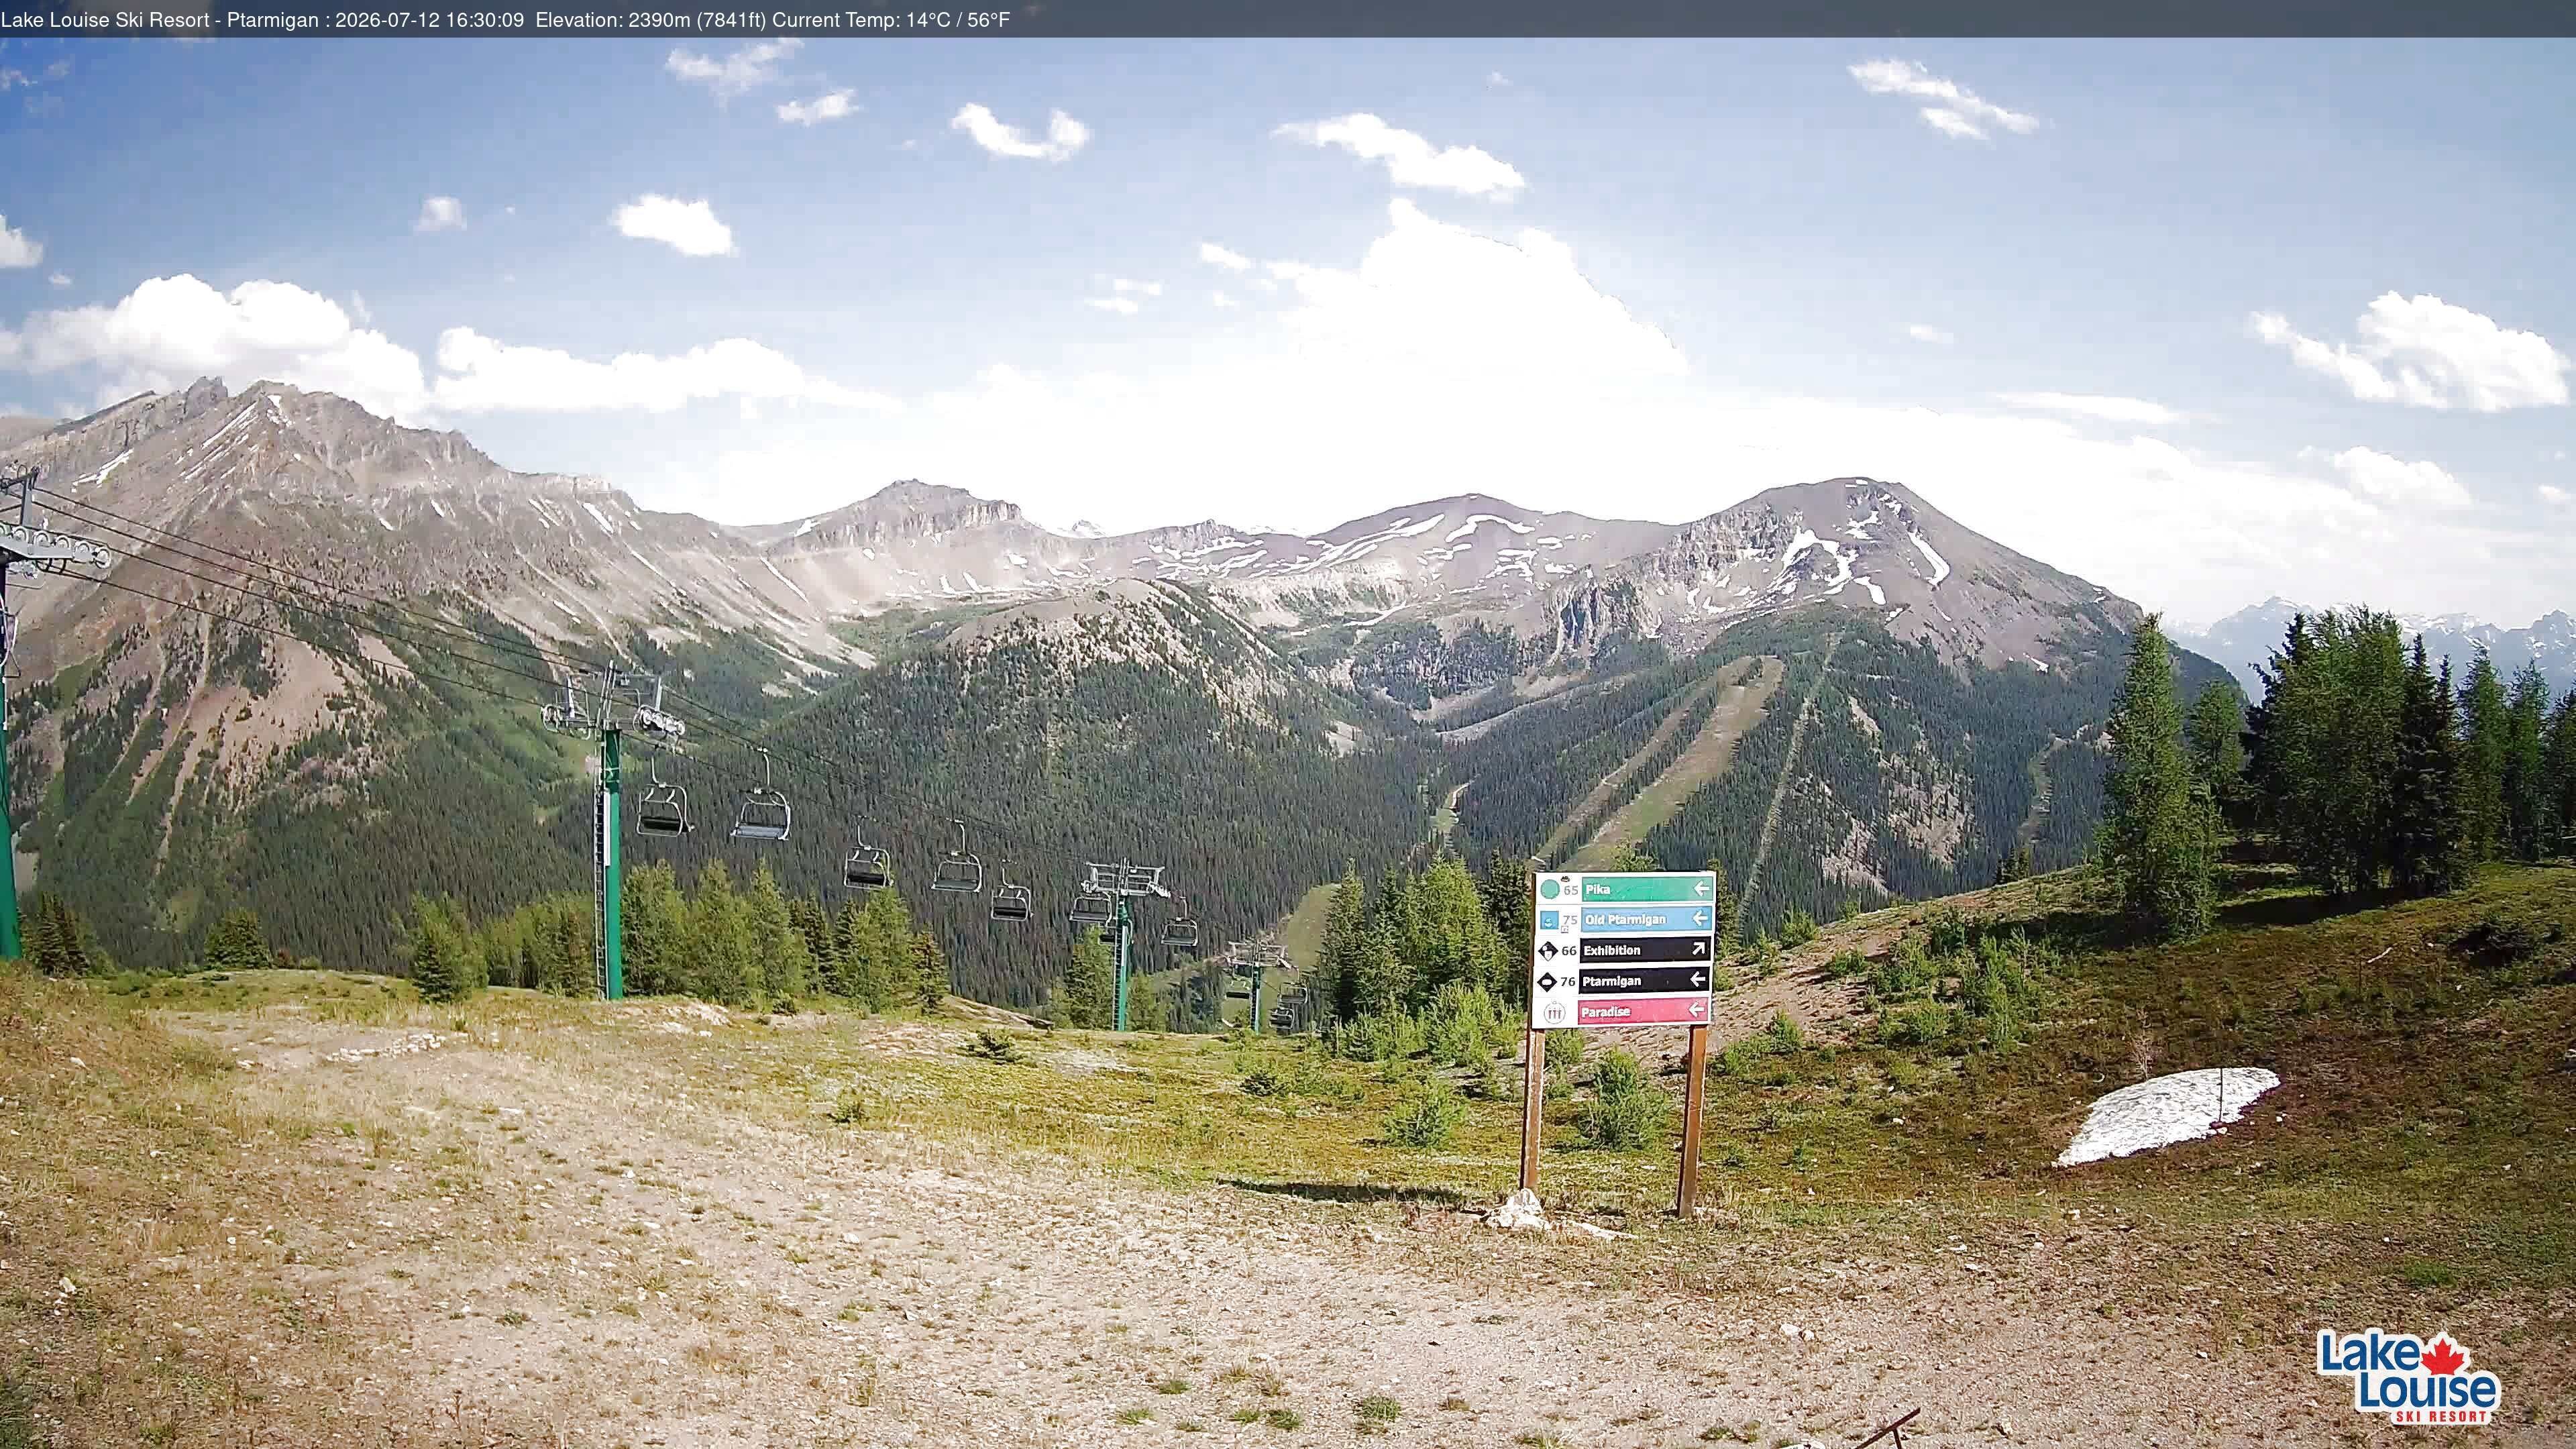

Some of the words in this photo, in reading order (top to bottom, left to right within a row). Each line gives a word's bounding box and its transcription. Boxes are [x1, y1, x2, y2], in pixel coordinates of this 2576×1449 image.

[1564, 885, 1578, 896] 65
[1585, 884, 1611, 895] Pika
[1563, 914, 1578, 925] 75
[1585, 914, 1605, 926] Old
[1608, 913, 1667, 926] Ptarmigan
[1561, 946, 1576, 956] 66
[1583, 945, 1642, 957] Exhibition
[1560, 976, 1576, 987] 76
[1582, 975, 1642, 988] Ptarmigan
[1580, 1006, 1631, 1018] Paradise
